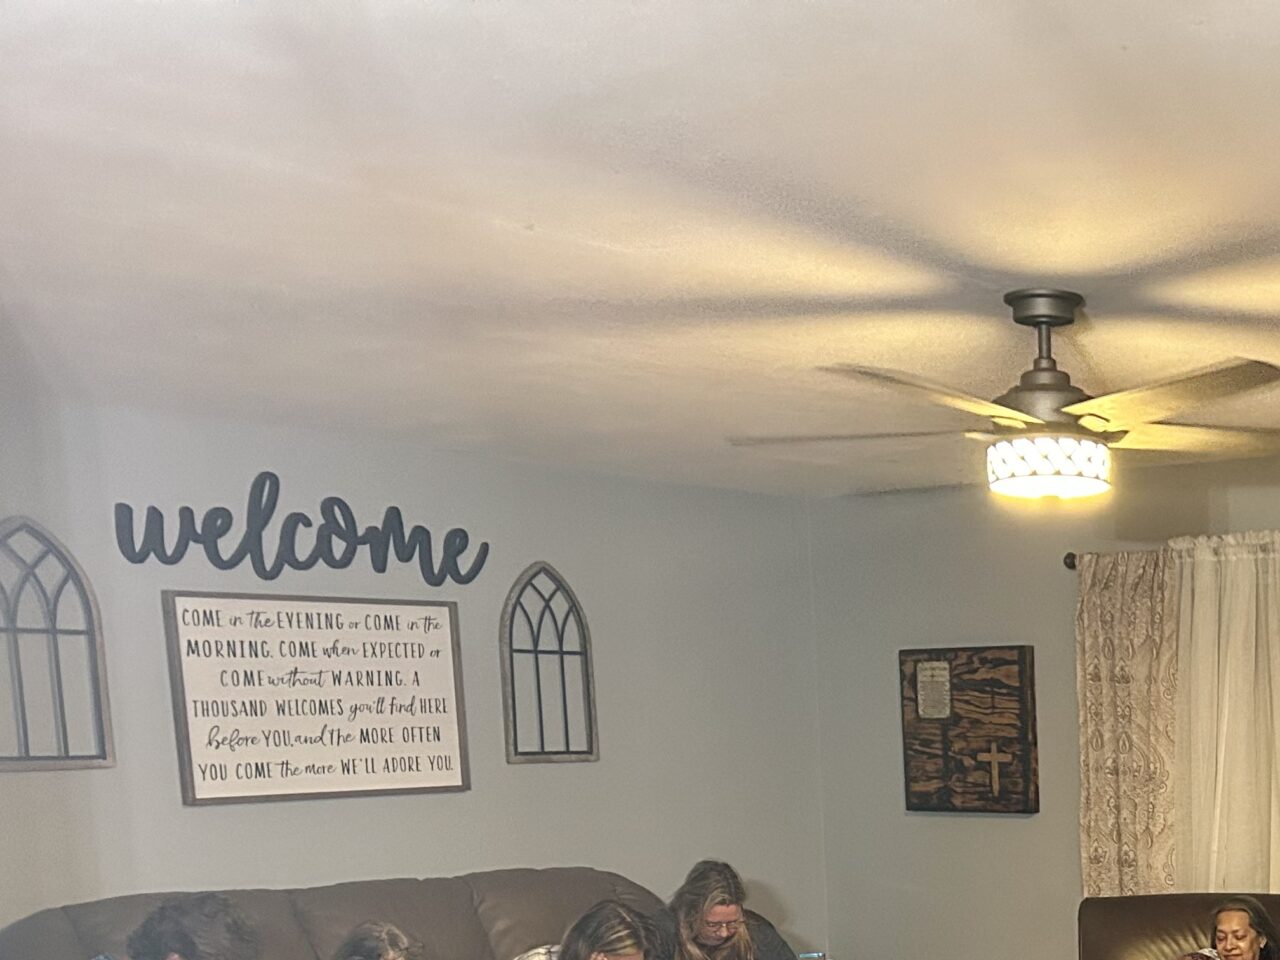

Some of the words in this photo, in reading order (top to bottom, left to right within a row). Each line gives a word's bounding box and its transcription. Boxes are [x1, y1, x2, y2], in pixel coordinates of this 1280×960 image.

[114, 471, 490, 587] welcome
[182, 608, 222, 627] COME
[228, 614, 243, 627] in
[276, 611, 344, 630] EVENING
[348, 620, 361, 630] or
[364, 614, 401, 631] COME
[406, 620, 420, 631] in
[417, 615, 444, 634] the
[279, 640, 319, 659] COME
[322, 639, 360, 659] when
[362, 641, 425, 659] EXPECTED
[429, 648, 441, 659] or
[220, 669, 265, 688] COME
[266, 666, 331, 689] without
[412, 670, 421, 687] A
[192, 699, 267, 718] THOUSAND
[275, 698, 344, 717] WELCOMES
[347, 696, 386, 722] you'll
[388, 694, 417, 716] find
[419, 697, 448, 715] HERE
[206, 724, 259, 752] before
[294, 723, 328, 746] and
[359, 727, 395, 745] MORE
[402, 726, 441, 743] OFTEN
[198, 763, 228, 781] YOU
[235, 762, 272, 780] COME
[273, 760, 303, 778] the
[304, 763, 336, 776] more
[341, 757, 378, 776] WE'LL
[382, 755, 422, 774] ADORE
